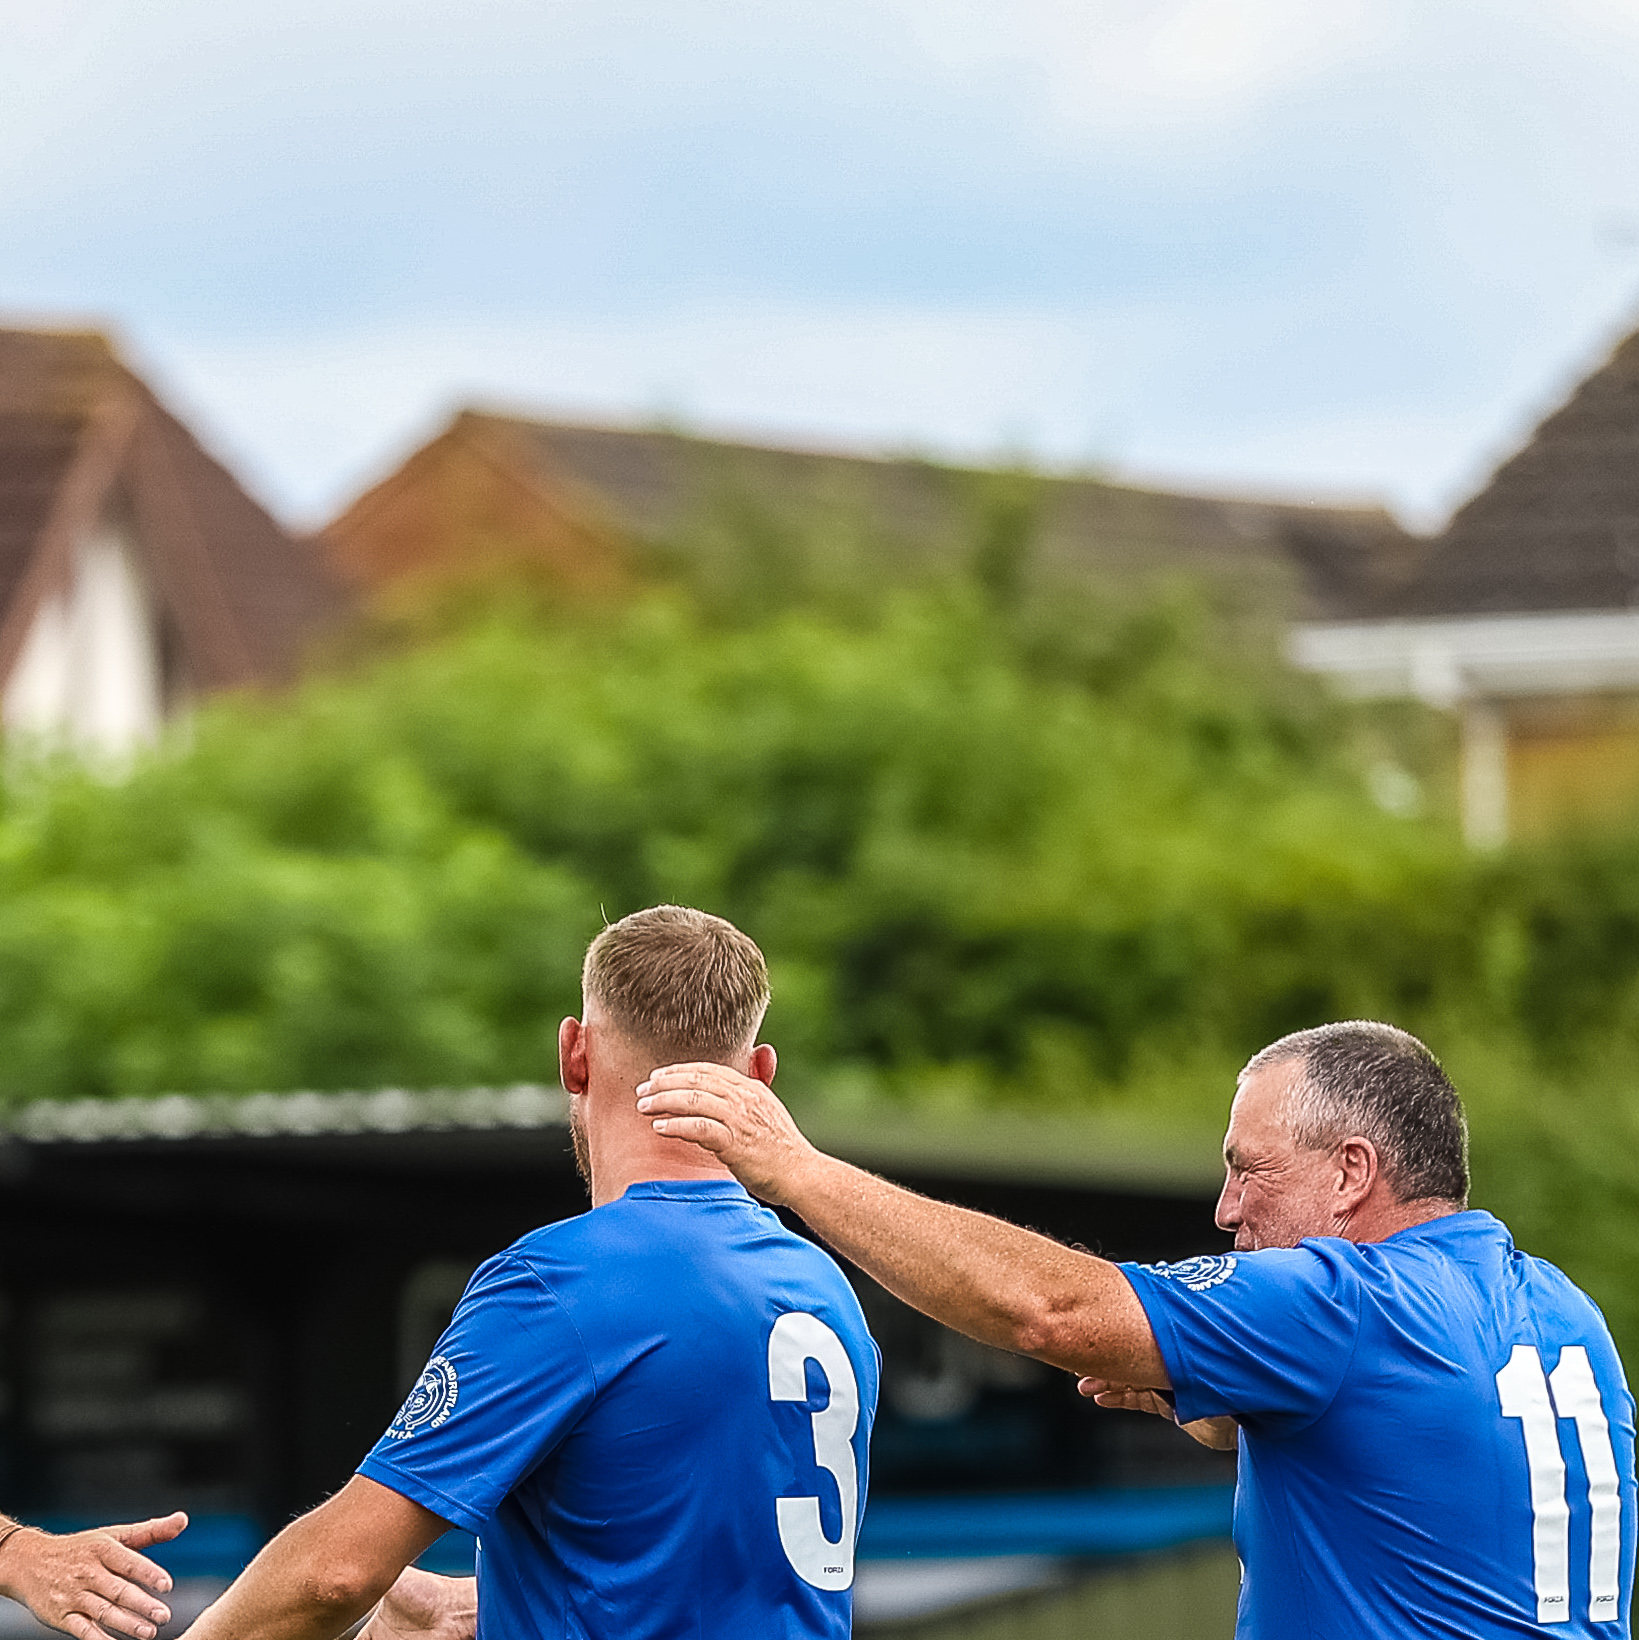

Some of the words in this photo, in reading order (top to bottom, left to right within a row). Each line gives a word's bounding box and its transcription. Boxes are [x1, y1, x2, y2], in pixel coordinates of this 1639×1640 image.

[430, 1381, 459, 1429] RUTLAND
[767, 1310, 860, 1592] 3
[1495, 1343, 1622, 1624] 11
